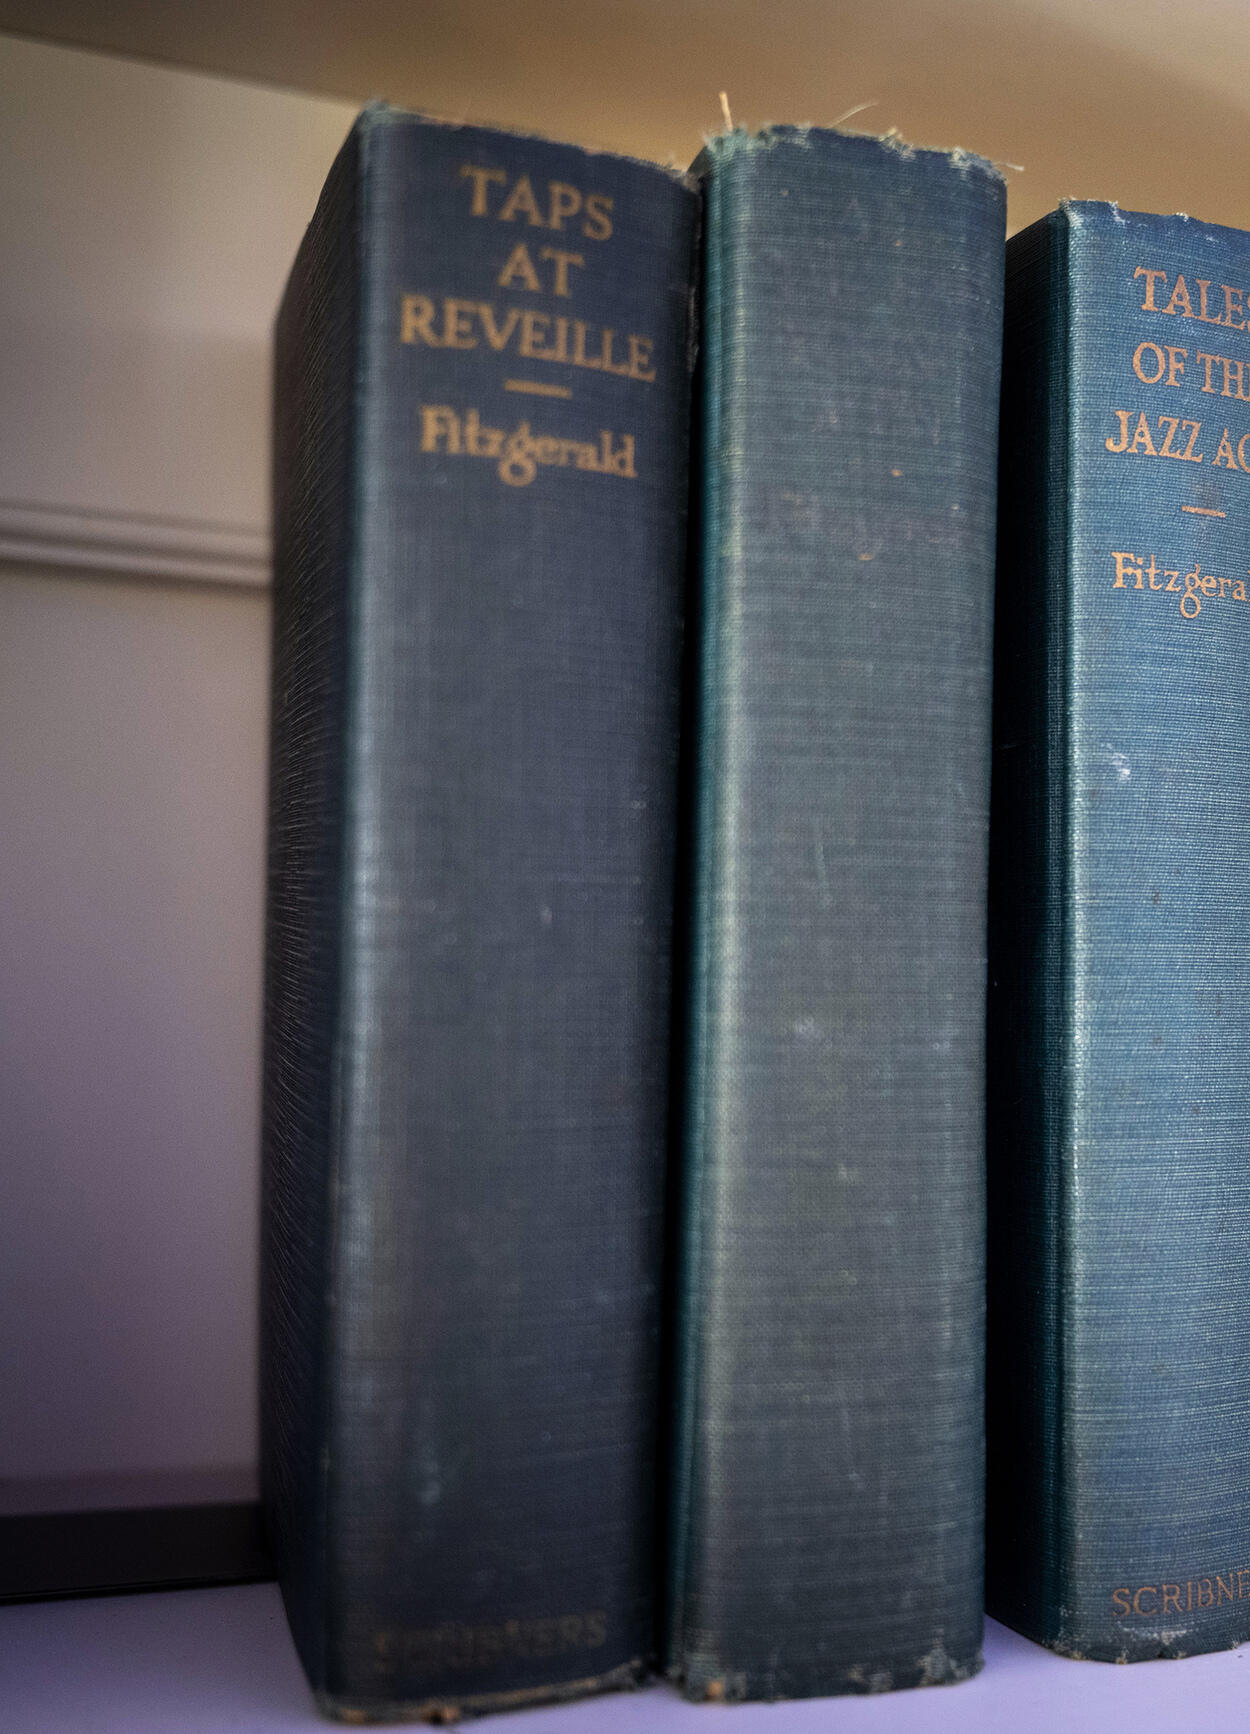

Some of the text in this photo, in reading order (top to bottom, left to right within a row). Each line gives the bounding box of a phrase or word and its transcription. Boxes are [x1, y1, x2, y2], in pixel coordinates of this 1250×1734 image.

[460, 164, 614, 241] TAPS
[498, 242, 585, 298] AT
[400, 293, 656, 382] REVEILLE
[1132, 341, 1188, 387] OF
[420, 404, 638, 487] Fitzgerald
[1105, 409, 1203, 463] JAZZ
